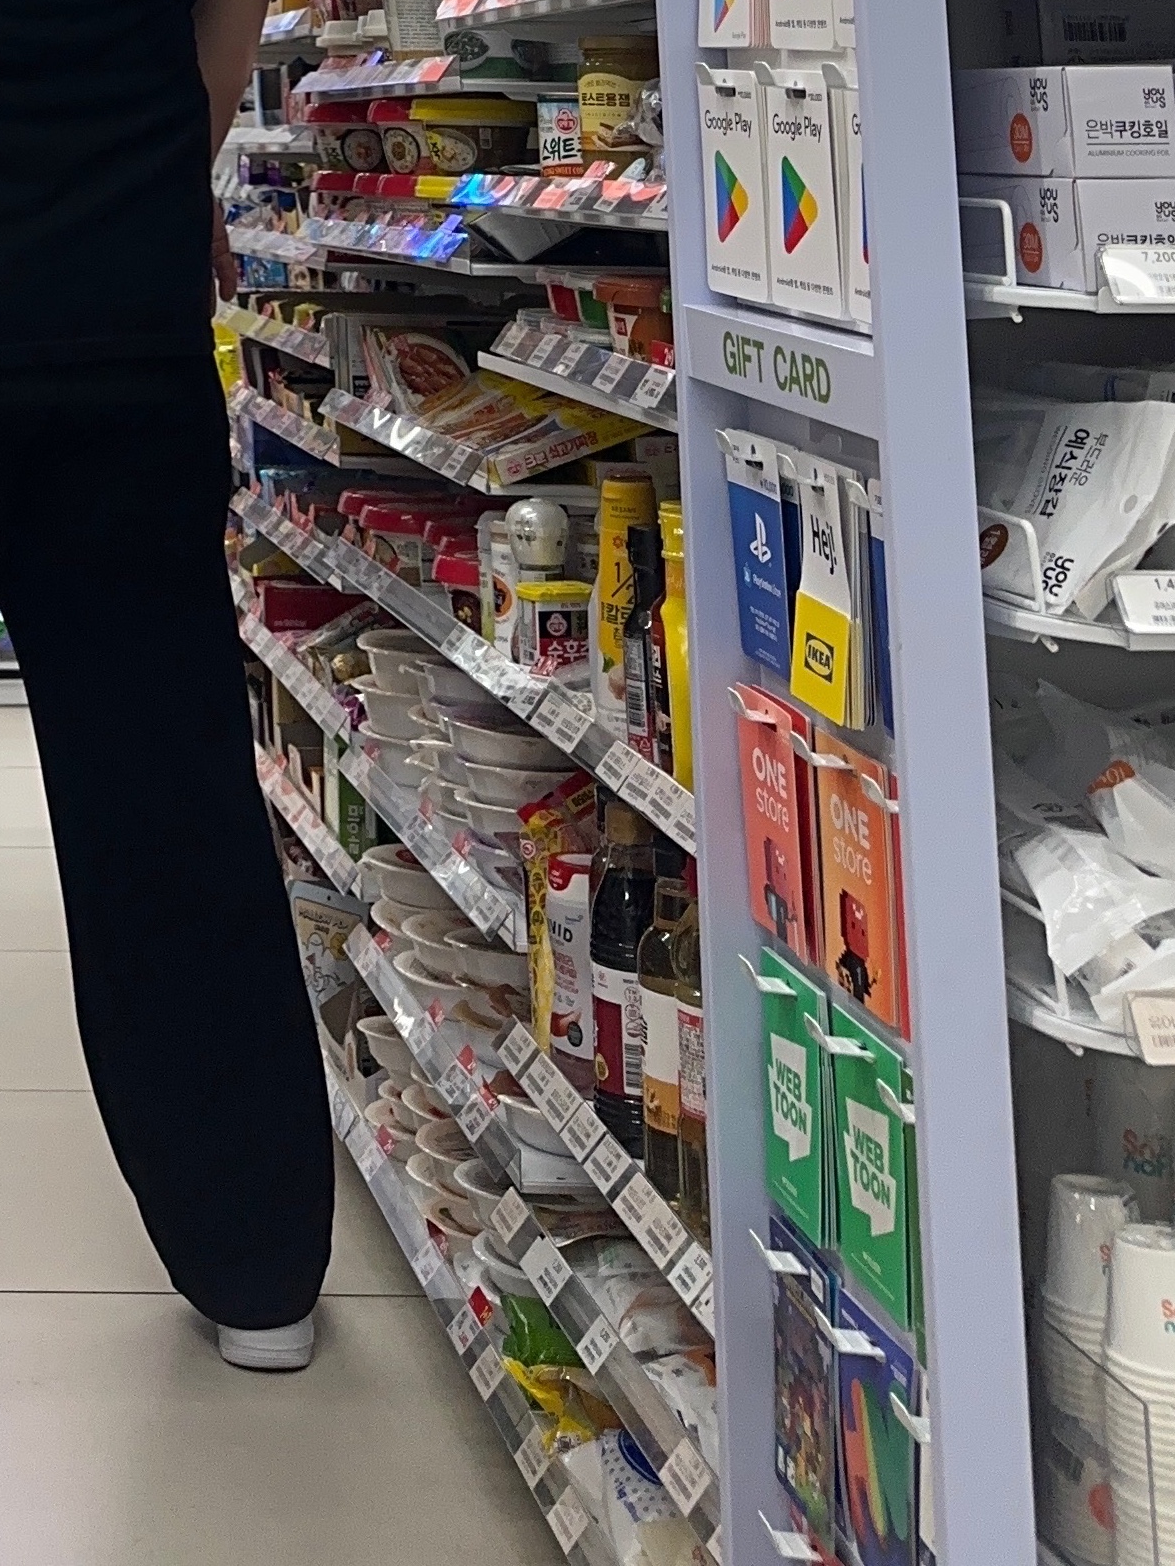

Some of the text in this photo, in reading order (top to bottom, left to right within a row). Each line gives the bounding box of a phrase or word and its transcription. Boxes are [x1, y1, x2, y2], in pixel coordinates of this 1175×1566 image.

[704, 109, 752, 138] Google Play
[772, 113, 822, 143] Google Play
[1085, 119, 1169, 140] 은박쿠킹호일
[722, 330, 831, 405] GIFT CARD
[809, 513, 838, 576] Hej!
[807, 643, 831, 671] IKEA
[751, 746, 788, 800] ONE
[755, 786, 790, 833] store
[829, 793, 871, 850] ONE
[832, 836, 872, 886] store
[775, 1058, 802, 1103] WEB
[773, 1080, 808, 1136] TOON
[853, 1124, 885, 1175] WEB
[850, 1148, 891, 1210] TOON
